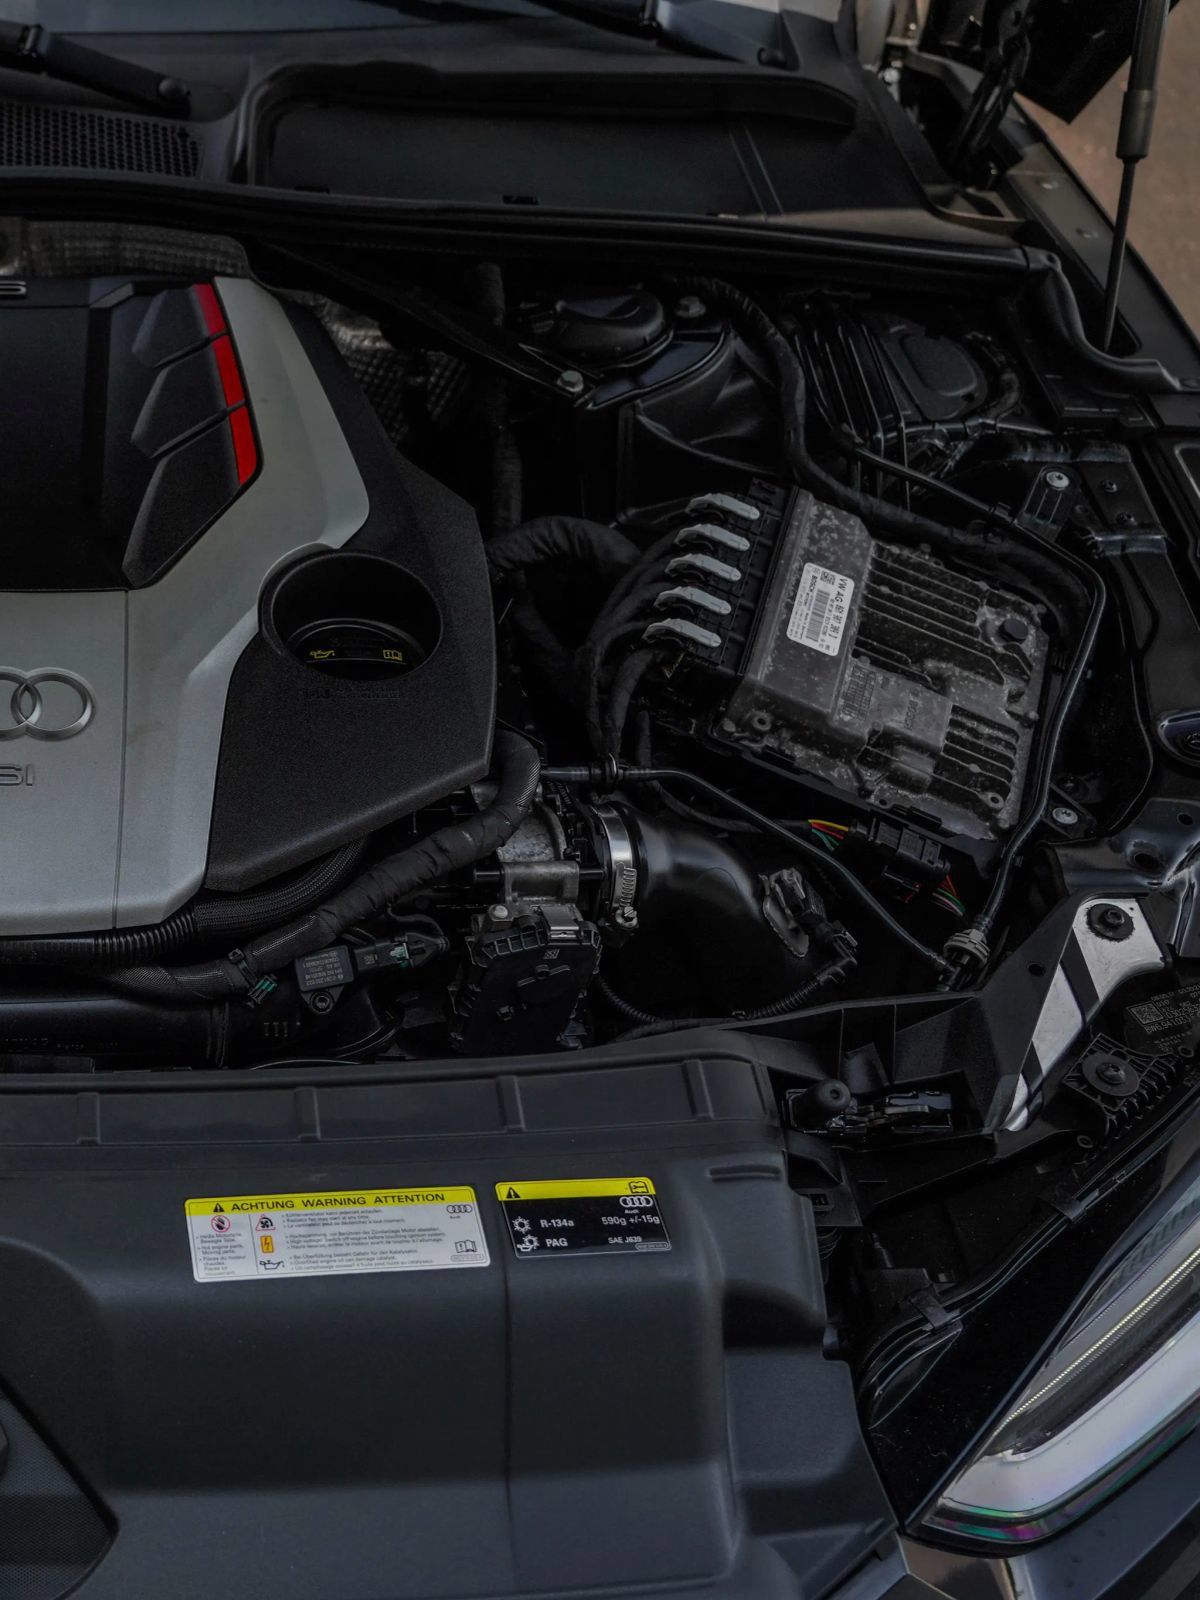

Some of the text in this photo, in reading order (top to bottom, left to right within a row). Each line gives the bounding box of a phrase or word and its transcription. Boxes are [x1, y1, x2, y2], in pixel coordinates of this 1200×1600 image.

[231, 1193, 445, 1211] ACHTUNG WARNING ATTENTION
[540, 1214, 660, 1229] R-134a 590g +/-15g
[545, 1238, 568, 1247] PAG
